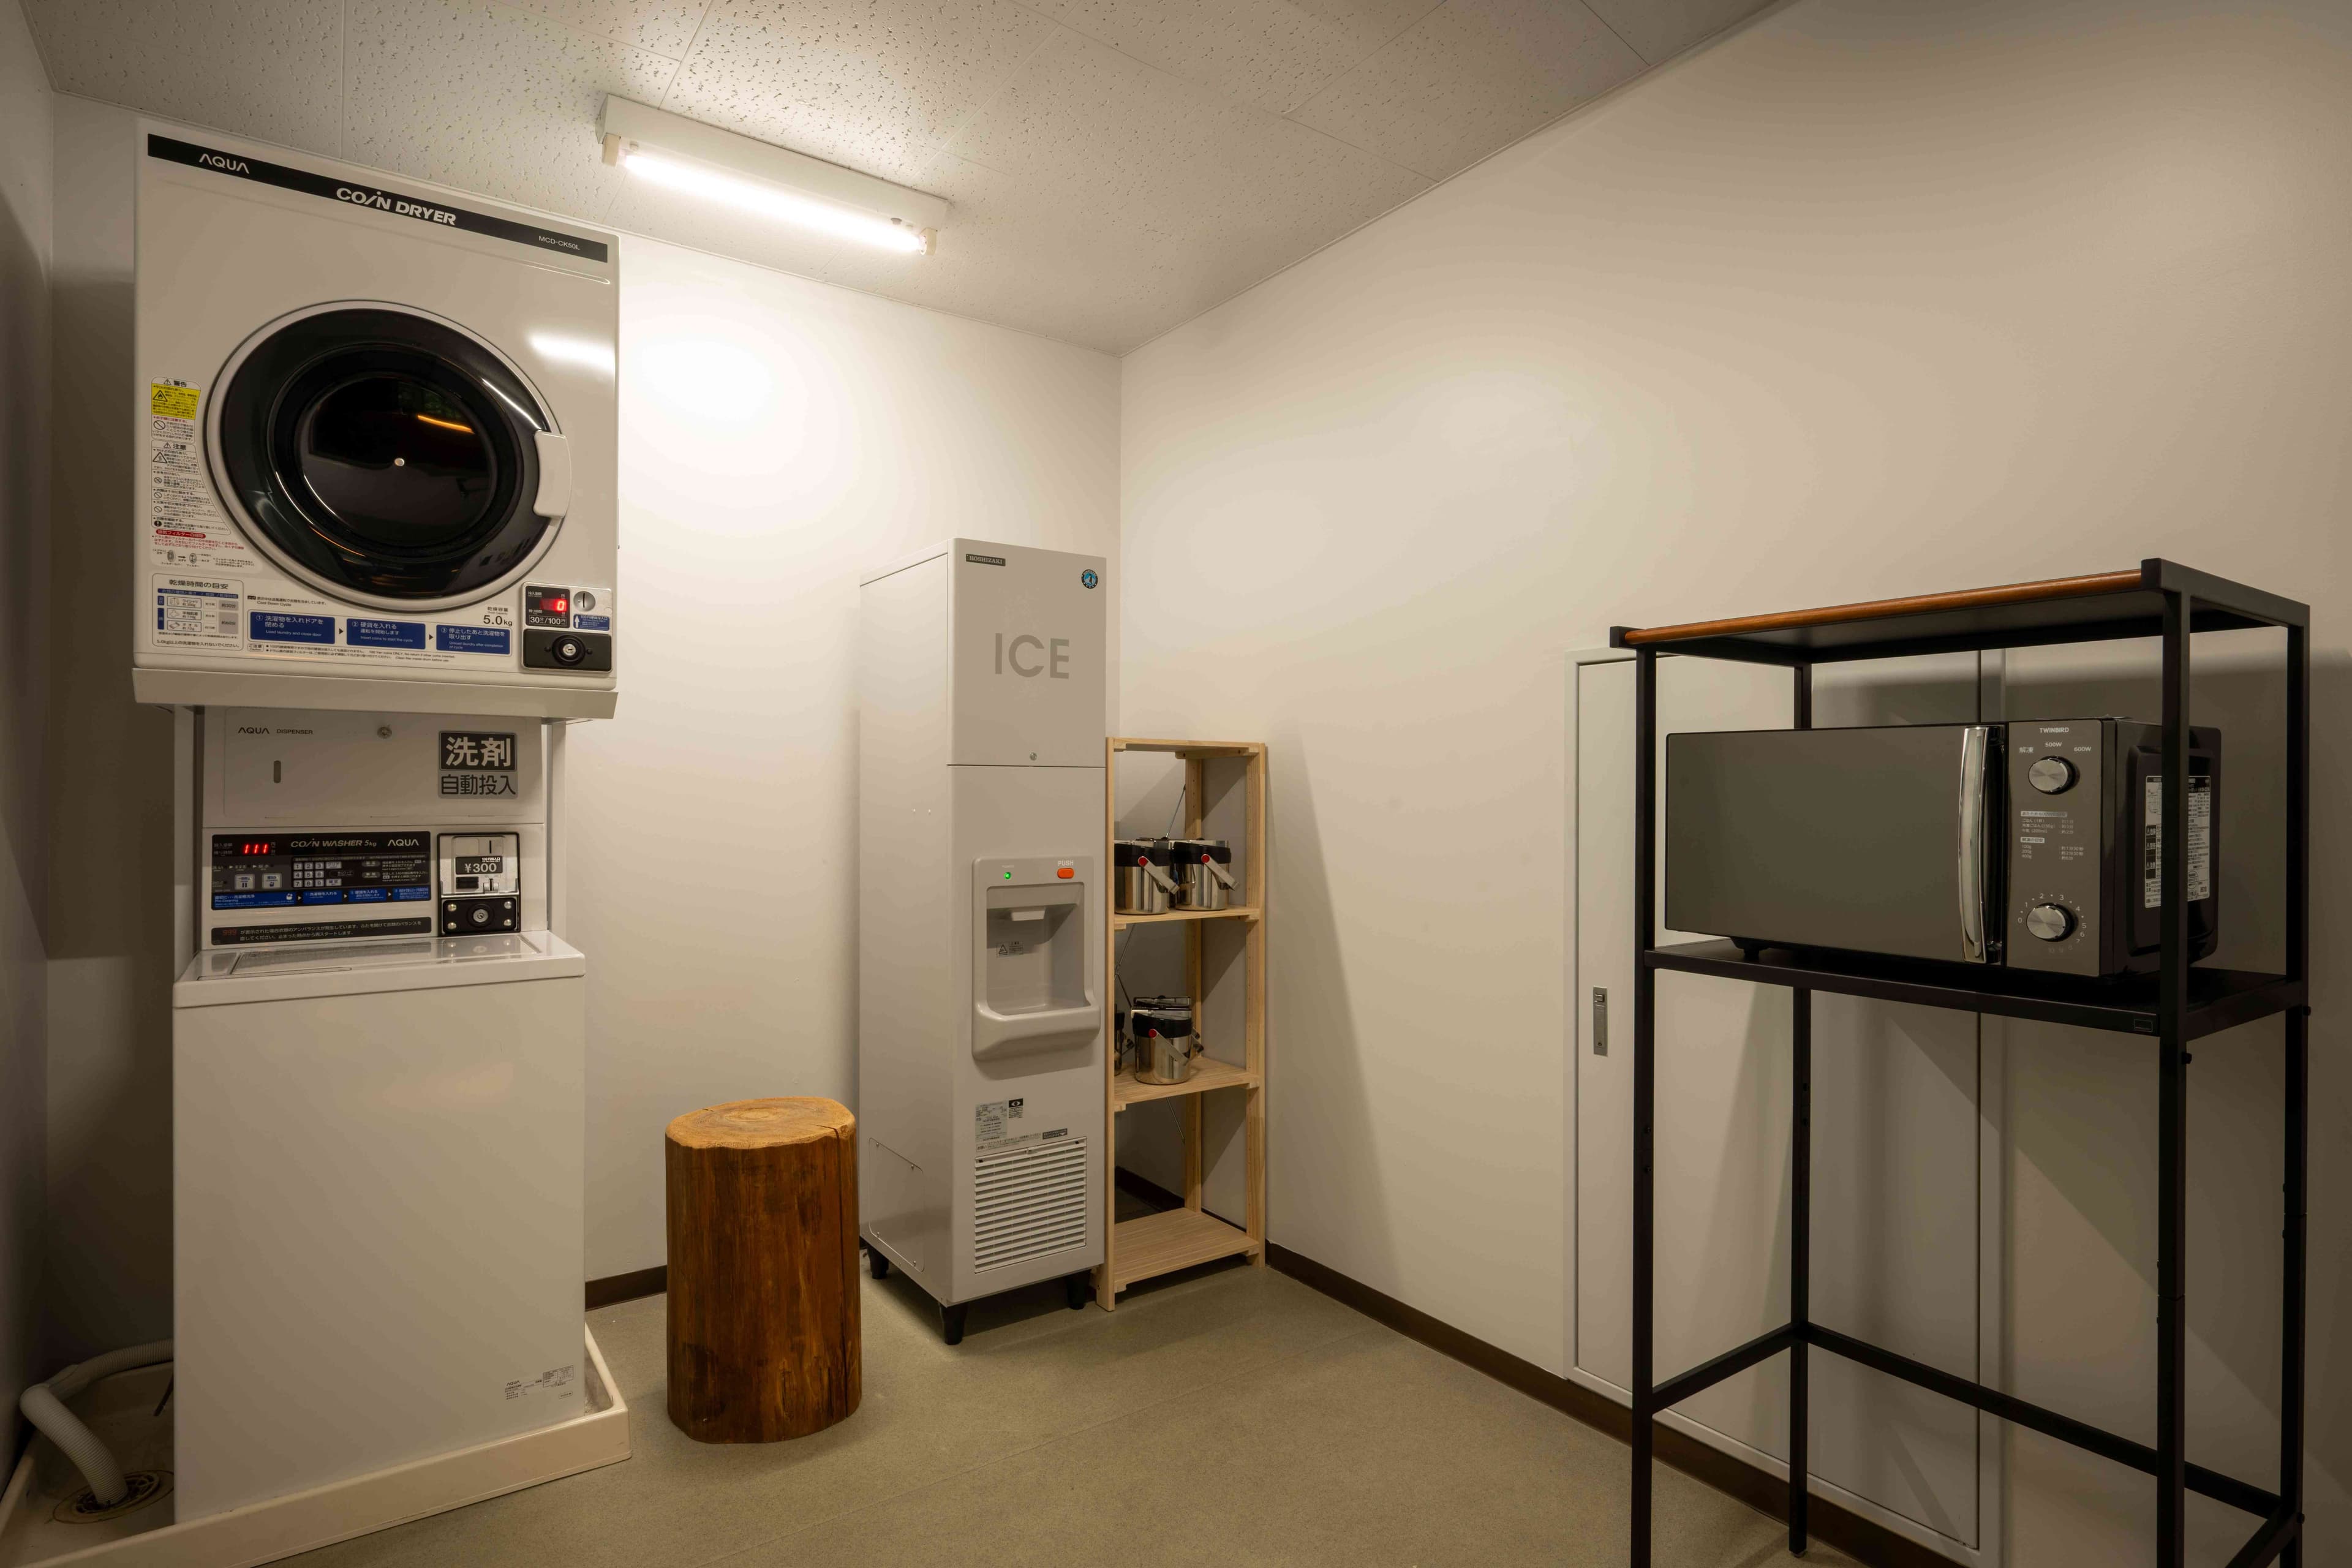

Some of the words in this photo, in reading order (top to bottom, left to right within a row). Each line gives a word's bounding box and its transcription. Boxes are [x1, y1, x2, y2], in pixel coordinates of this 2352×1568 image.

[198, 153, 250, 174] AQUA
[395, 200, 457, 225] DRYER
[538, 236, 581, 251] MCD-CK50L
[970, 556, 1003, 564] HOSHIZAKI
[169, 579, 228, 589] 乾燥時間の目安
[265, 615, 324, 625] 洗濯物を入れドアを
[449, 628, 505, 637] 停止したあと洗濯物を
[995, 633, 1069, 679] ICE
[445, 736, 511, 767] 洗剤
[441, 774, 516, 795] 自動投入
[322, 839, 363, 848] WASHER
[387, 839, 420, 847] AQUA
[465, 862, 497, 873] ¥300
